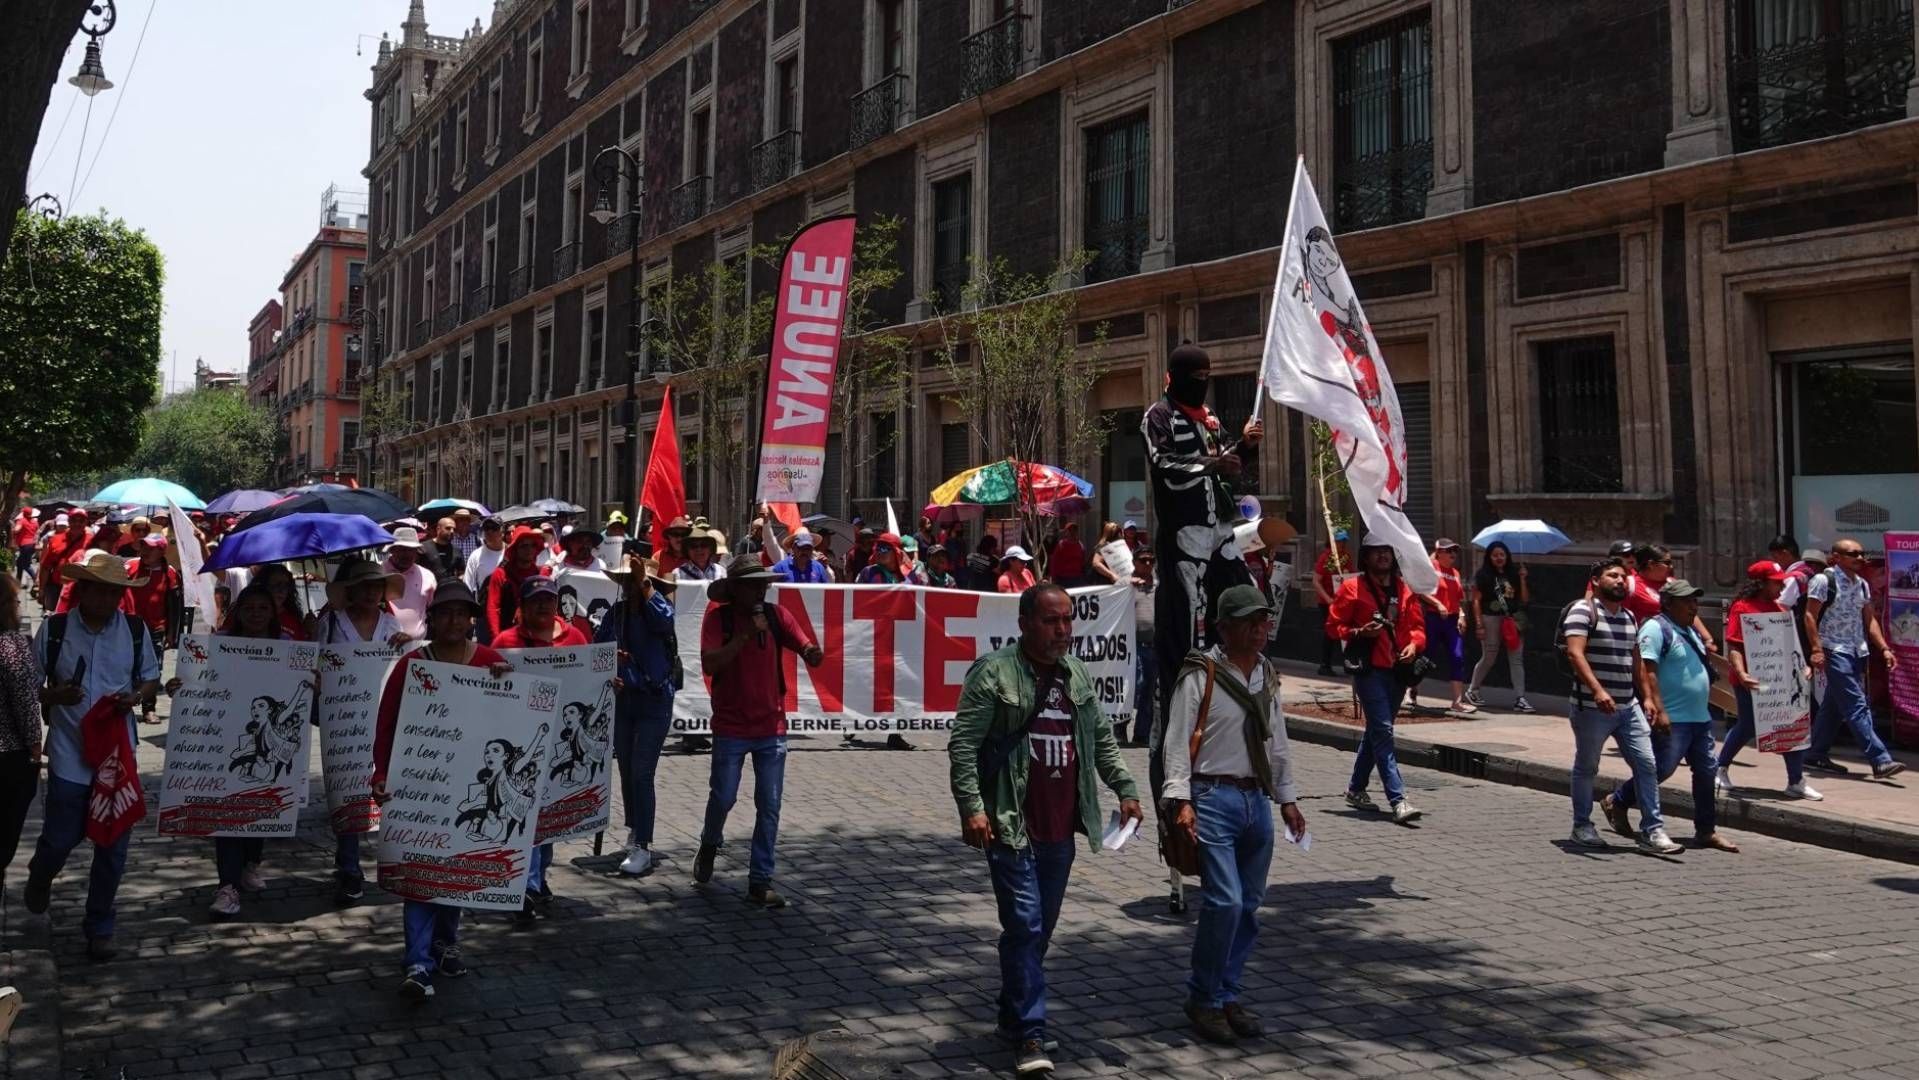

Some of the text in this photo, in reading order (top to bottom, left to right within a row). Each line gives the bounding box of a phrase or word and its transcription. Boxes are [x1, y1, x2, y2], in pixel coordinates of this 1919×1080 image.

[219, 642, 273, 657] Sección 9
[701, 588, 980, 714] NTE
[523, 653, 577, 665] Sección 9
[451, 673, 513, 691] Sección 9
[425, 703, 449, 718] Me
[403, 723, 463, 742] enseñaste
[853, 719, 889, 731] LOS
[896, 719, 957, 731] DEREC
[404, 744, 456, 763] a leer y
[166, 775, 226, 791] LUCHAR.
[393, 785, 450, 805] ahora me
[387, 808, 437, 825] enseñas
[441, 817, 450, 826] a
[384, 825, 451, 849] LUCHAR.
[472, 891, 521, 904] VENCEREMOS!
